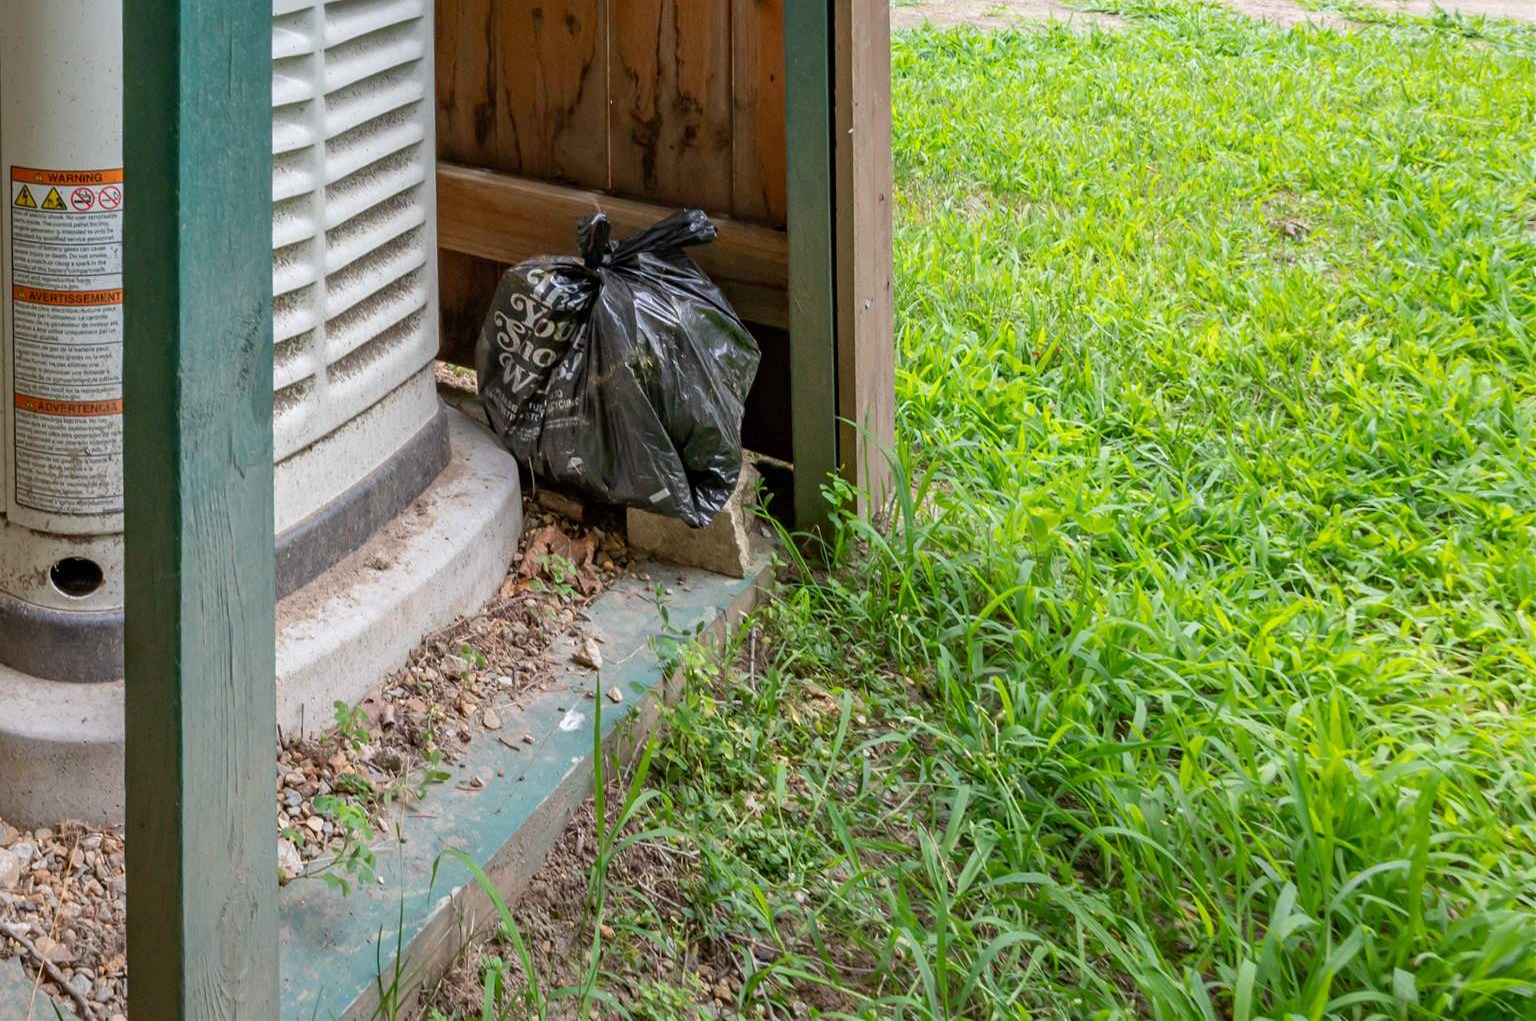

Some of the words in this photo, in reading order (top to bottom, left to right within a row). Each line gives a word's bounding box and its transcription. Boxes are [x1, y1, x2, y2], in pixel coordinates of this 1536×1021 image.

[47, 173, 103, 183] WARNING
[28, 291, 121, 304] AVERTISSEMENT
[37, 401, 118, 414] ADVERTENCIA
